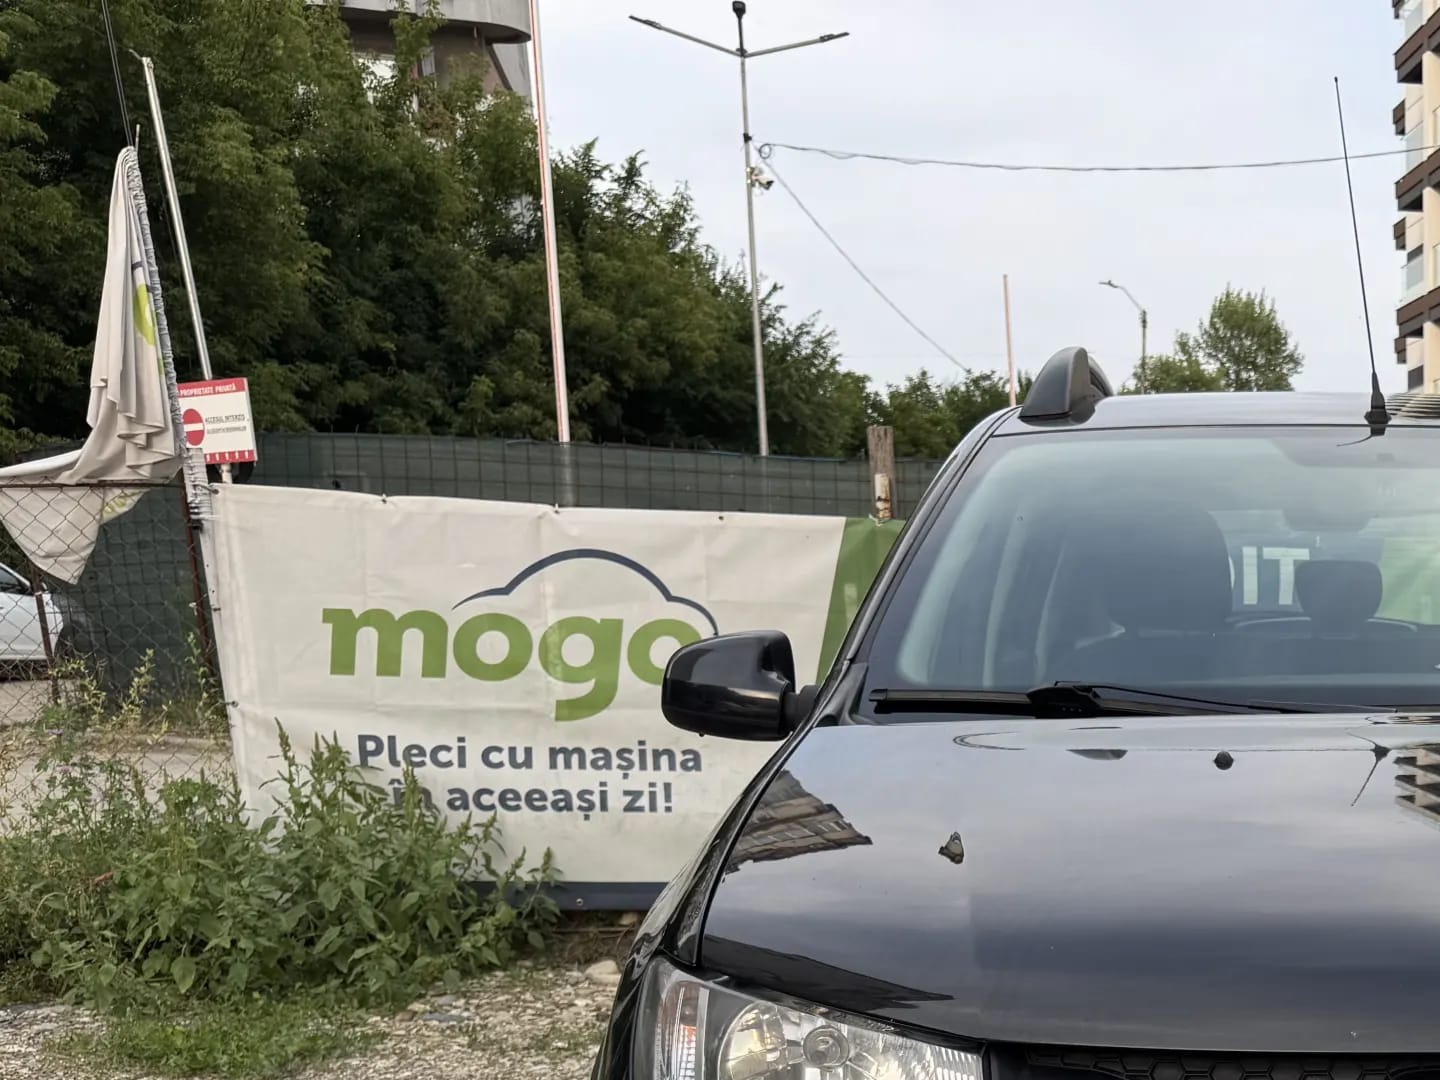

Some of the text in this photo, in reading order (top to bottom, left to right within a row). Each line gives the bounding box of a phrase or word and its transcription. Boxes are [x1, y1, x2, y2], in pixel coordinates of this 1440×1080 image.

[322, 608, 702, 722] mogo
[357, 734, 702, 780] Pleci cu mașina
[446, 781, 609, 821] aceeași
[622, 781, 673, 813] zi!
